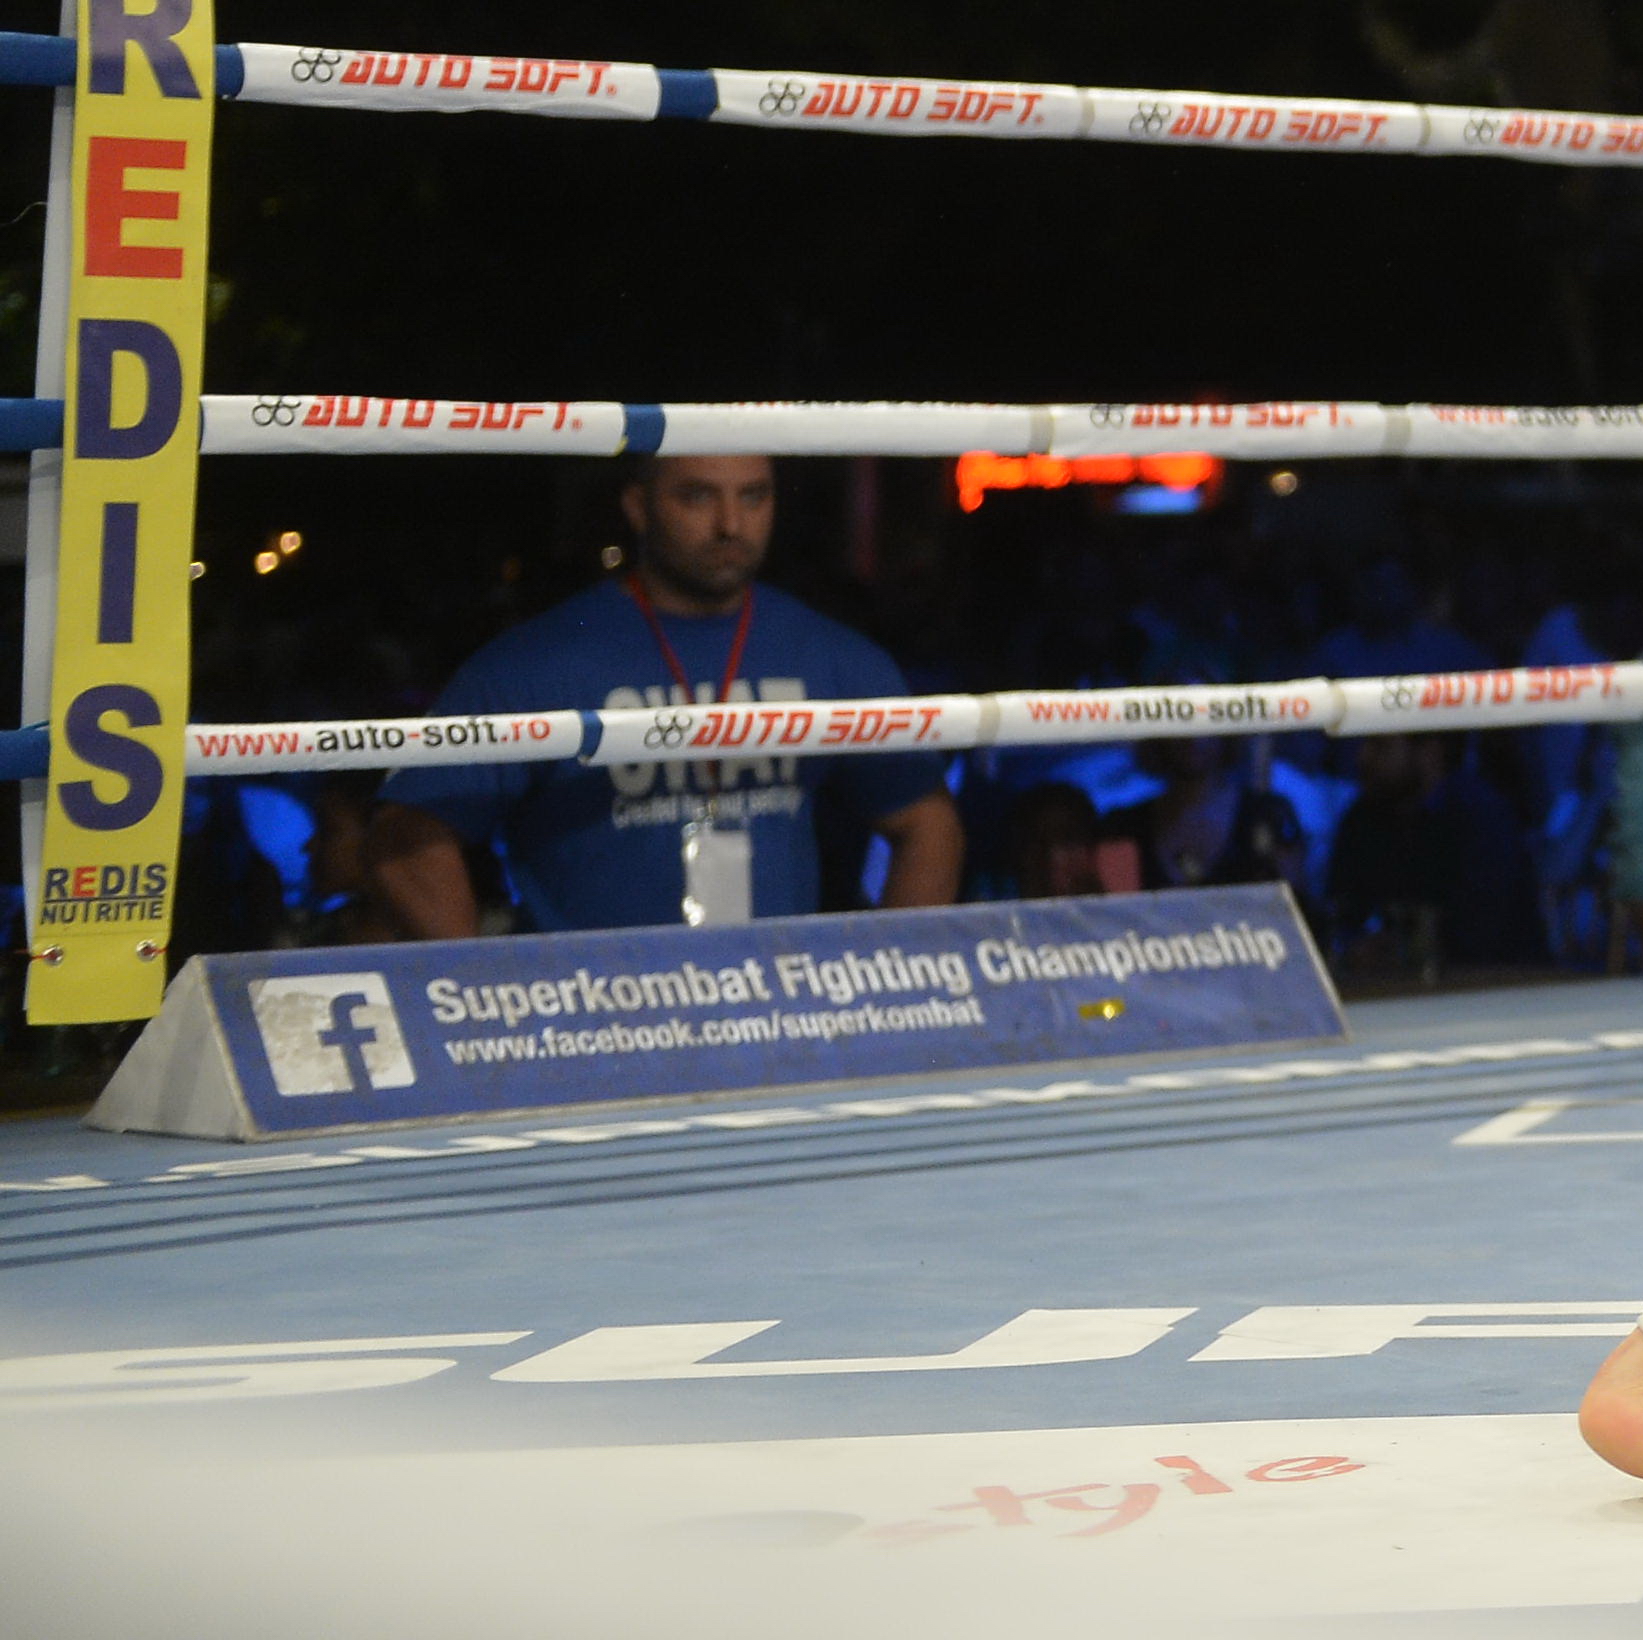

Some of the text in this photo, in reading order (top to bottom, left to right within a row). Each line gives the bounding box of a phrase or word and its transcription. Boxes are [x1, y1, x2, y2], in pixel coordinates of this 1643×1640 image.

[340, 52, 471, 88] AUTO
[803, 82, 921, 120] AUTO
[1169, 104, 1274, 141] AUTO
[690, 711, 816, 747] AUTO
[45, 864, 167, 899] REDIS
[40, 902, 163, 926] NUTRITIE
[426, 921, 1286, 1027] Superkombat Fighting Championship
[445, 996, 986, 1066] www.facebook.com/superkombat
